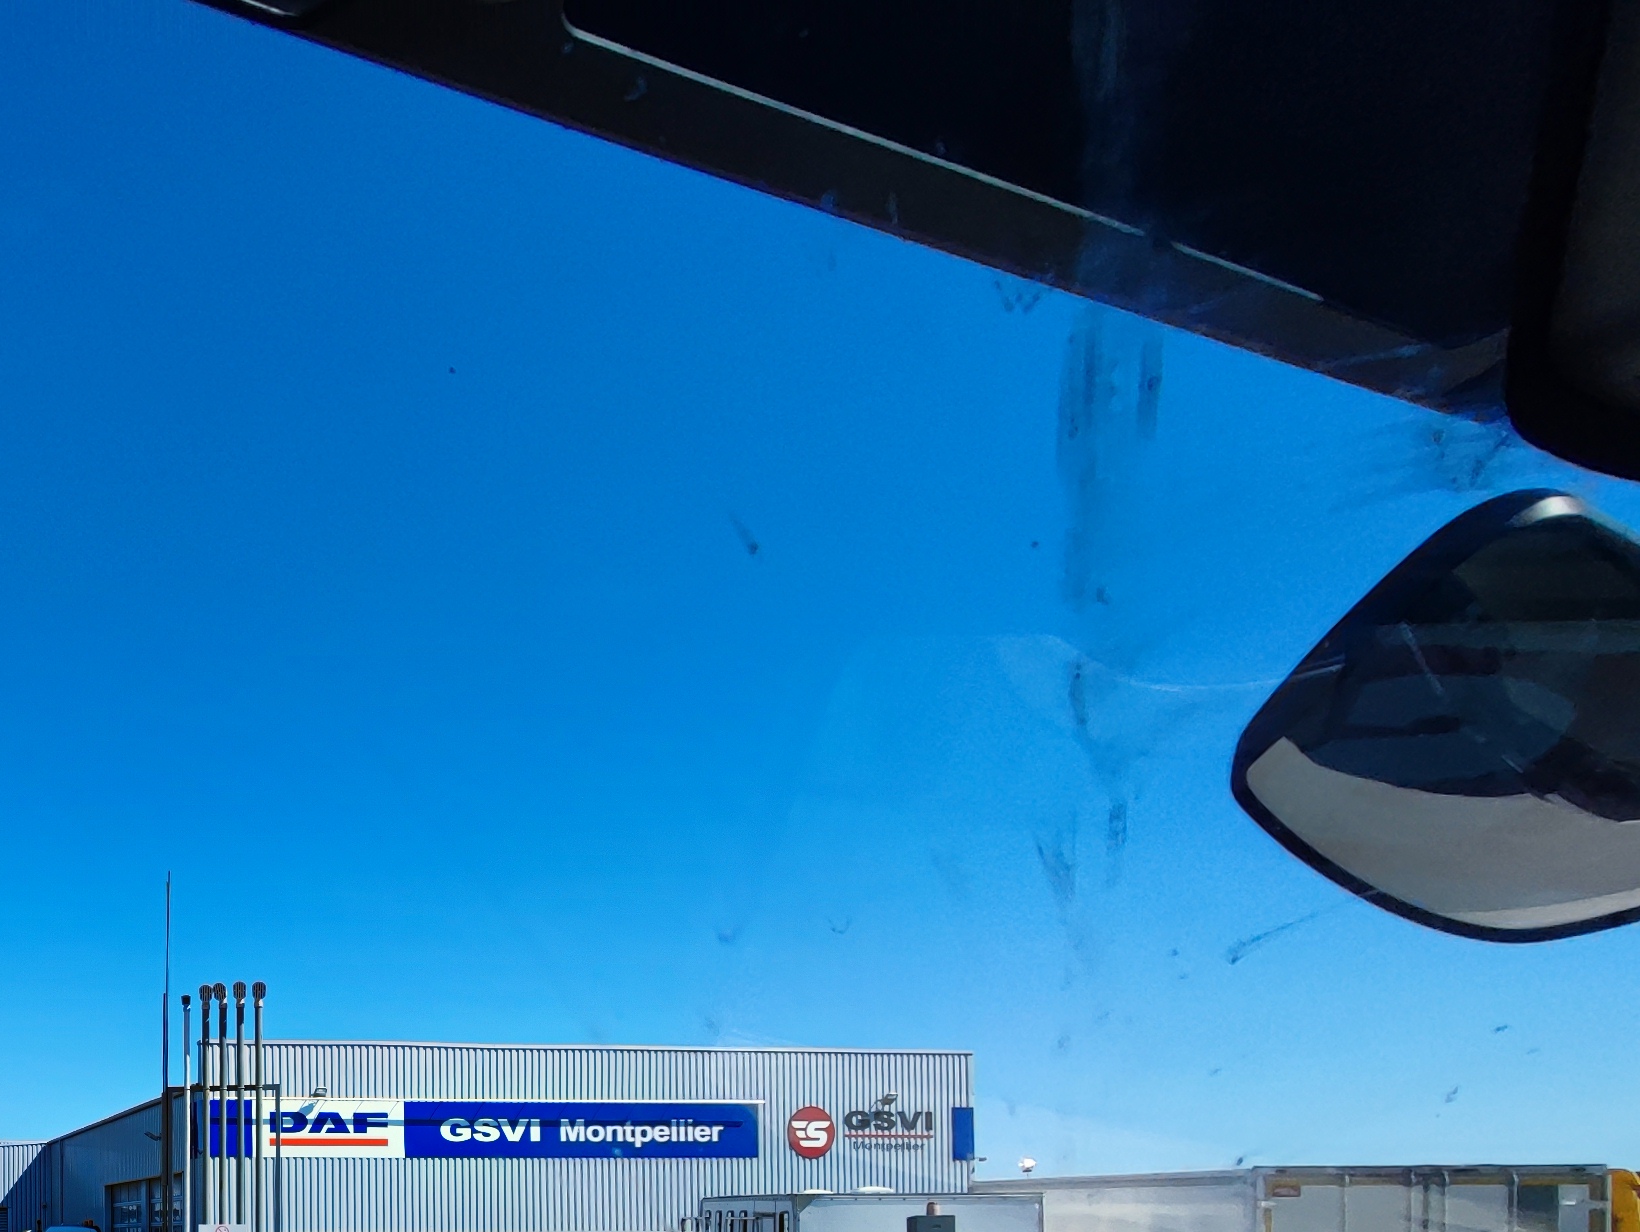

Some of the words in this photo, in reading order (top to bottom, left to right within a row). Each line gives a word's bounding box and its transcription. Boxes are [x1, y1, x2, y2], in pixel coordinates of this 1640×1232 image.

[269, 1111, 389, 1134] DAF
[844, 1110, 933, 1131] GSVI
[440, 1118, 541, 1142] GSVI
[560, 1118, 724, 1148] Montpellier
[853, 1141, 926, 1152] Montpellier
